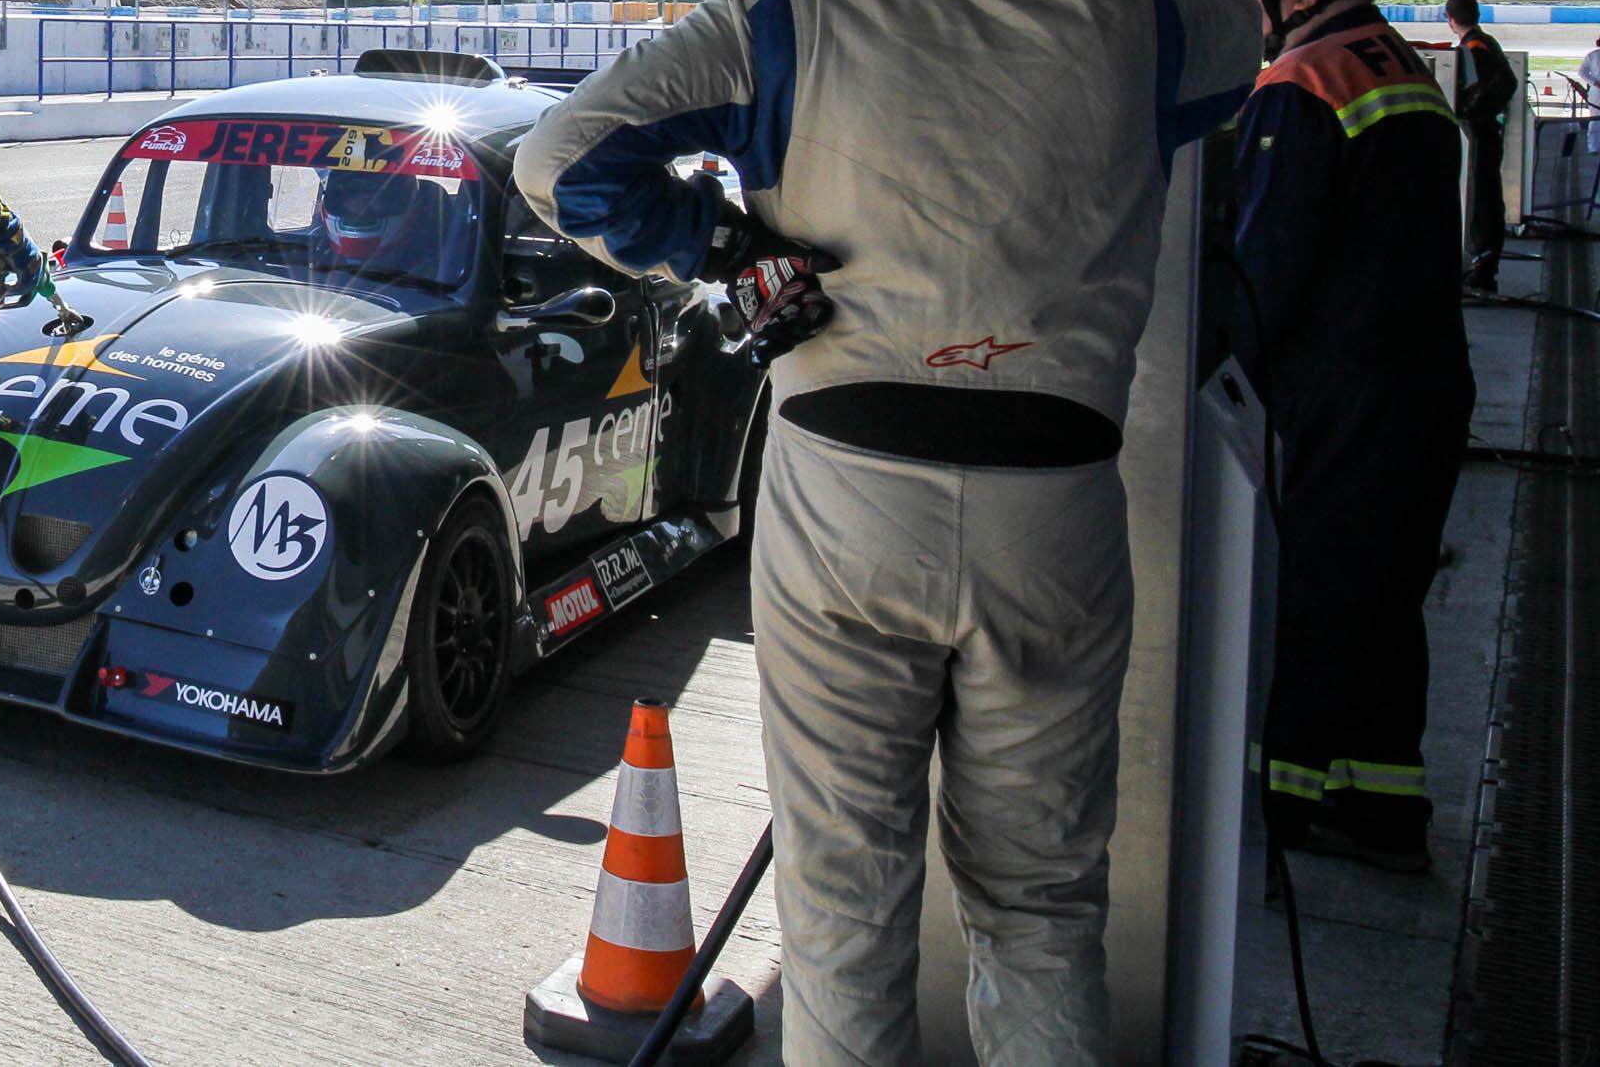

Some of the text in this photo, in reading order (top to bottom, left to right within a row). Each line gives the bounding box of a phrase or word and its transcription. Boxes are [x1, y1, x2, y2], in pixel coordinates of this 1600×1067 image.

[140, 141, 185, 154] FunCup
[199, 121, 347, 167] JEREZ
[341, 130, 351, 167] 2019
[411, 155, 463, 171] FunCup
[108, 349, 217, 383] des hommes
[159, 346, 226, 371] le génie
[509, 417, 591, 542] 45
[551, 583, 599, 631] MOTUL
[175, 682, 283, 726] YOKOHAMA
